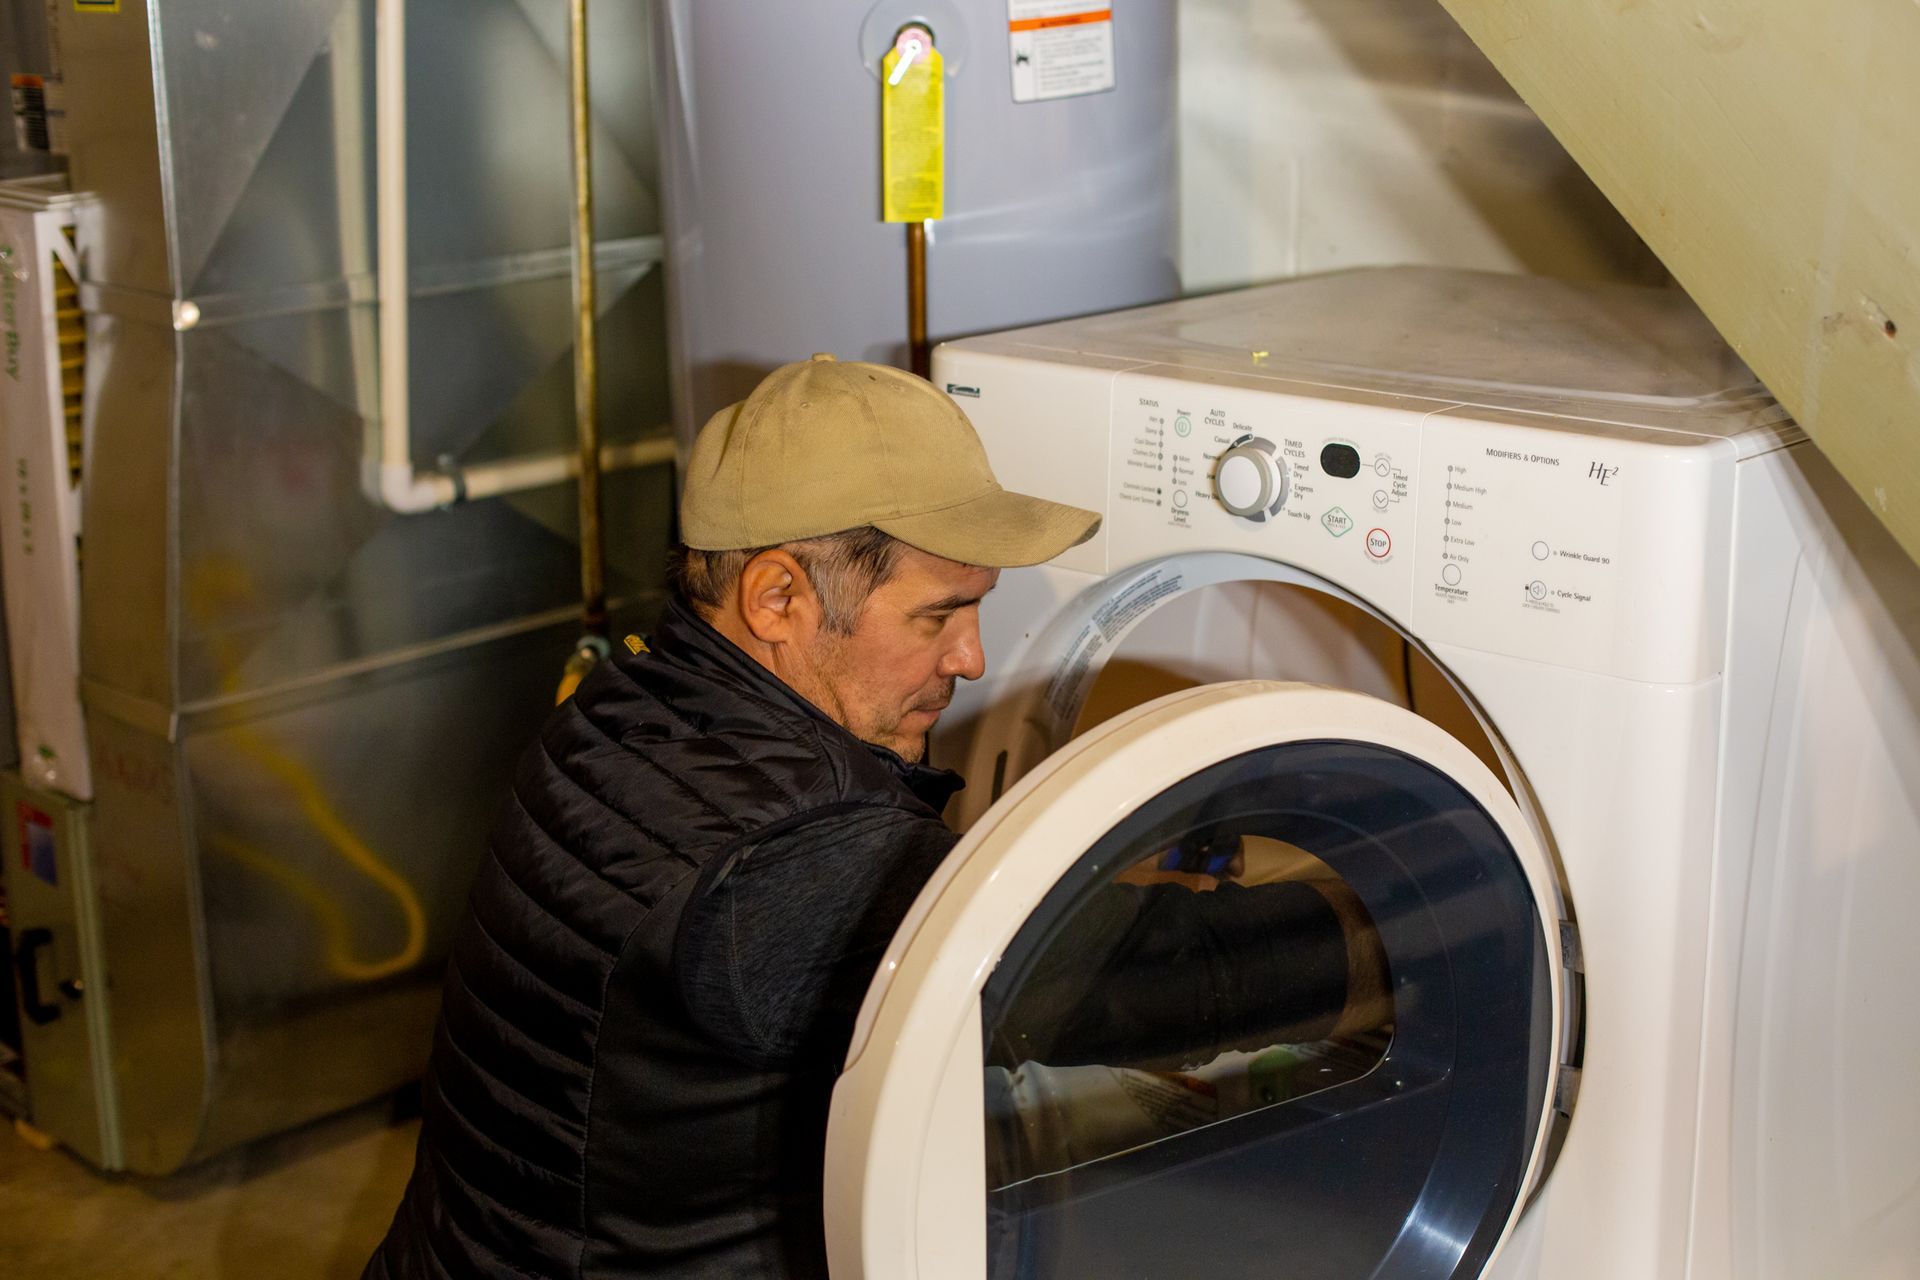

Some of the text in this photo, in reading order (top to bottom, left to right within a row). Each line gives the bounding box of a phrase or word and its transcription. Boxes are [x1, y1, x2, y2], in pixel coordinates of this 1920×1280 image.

[1139, 398, 1159, 408] STATUS
[1210, 409, 1225, 418] AUTO
[1204, 417, 1225, 427] CYCLES
[1232, 422, 1253, 432] Delicate
[1214, 435, 1230, 444] Casual
[1284, 439, 1302, 448] TIMED
[1284, 448, 1305, 458] CYCLES
[1486, 448, 1560, 466] MODIFIERS & OPTIONS
[1294, 463, 1309, 471] Timed
[1455, 465, 1467, 474] High
[1294, 471, 1302, 480] Dry
[1393, 473, 1408, 482] Timed
[1294, 484, 1313, 493] Express
[1393, 481, 1407, 490] Cycle
[1454, 483, 1487, 496] Medium High
[1195, 490, 1210, 500] Heavy
[1294, 492, 1303, 501] Dry
[1391, 489, 1407, 498] Adjust
[1452, 501, 1473, 510] Medium
[1174, 515, 1186, 523] Level
[1287, 509, 1311, 521] Touch Up
[1327, 514, 1347, 525] START
[1370, 538, 1387, 547] STOP
[1450, 536, 1475, 546] Extra Low
[1449, 553, 1469, 564] Air Only
[1559, 550, 1610, 565] Wrinkle Guard 90
[1434, 583, 1469, 597] Temperature
[1557, 589, 1591, 602] Cycle Signal
